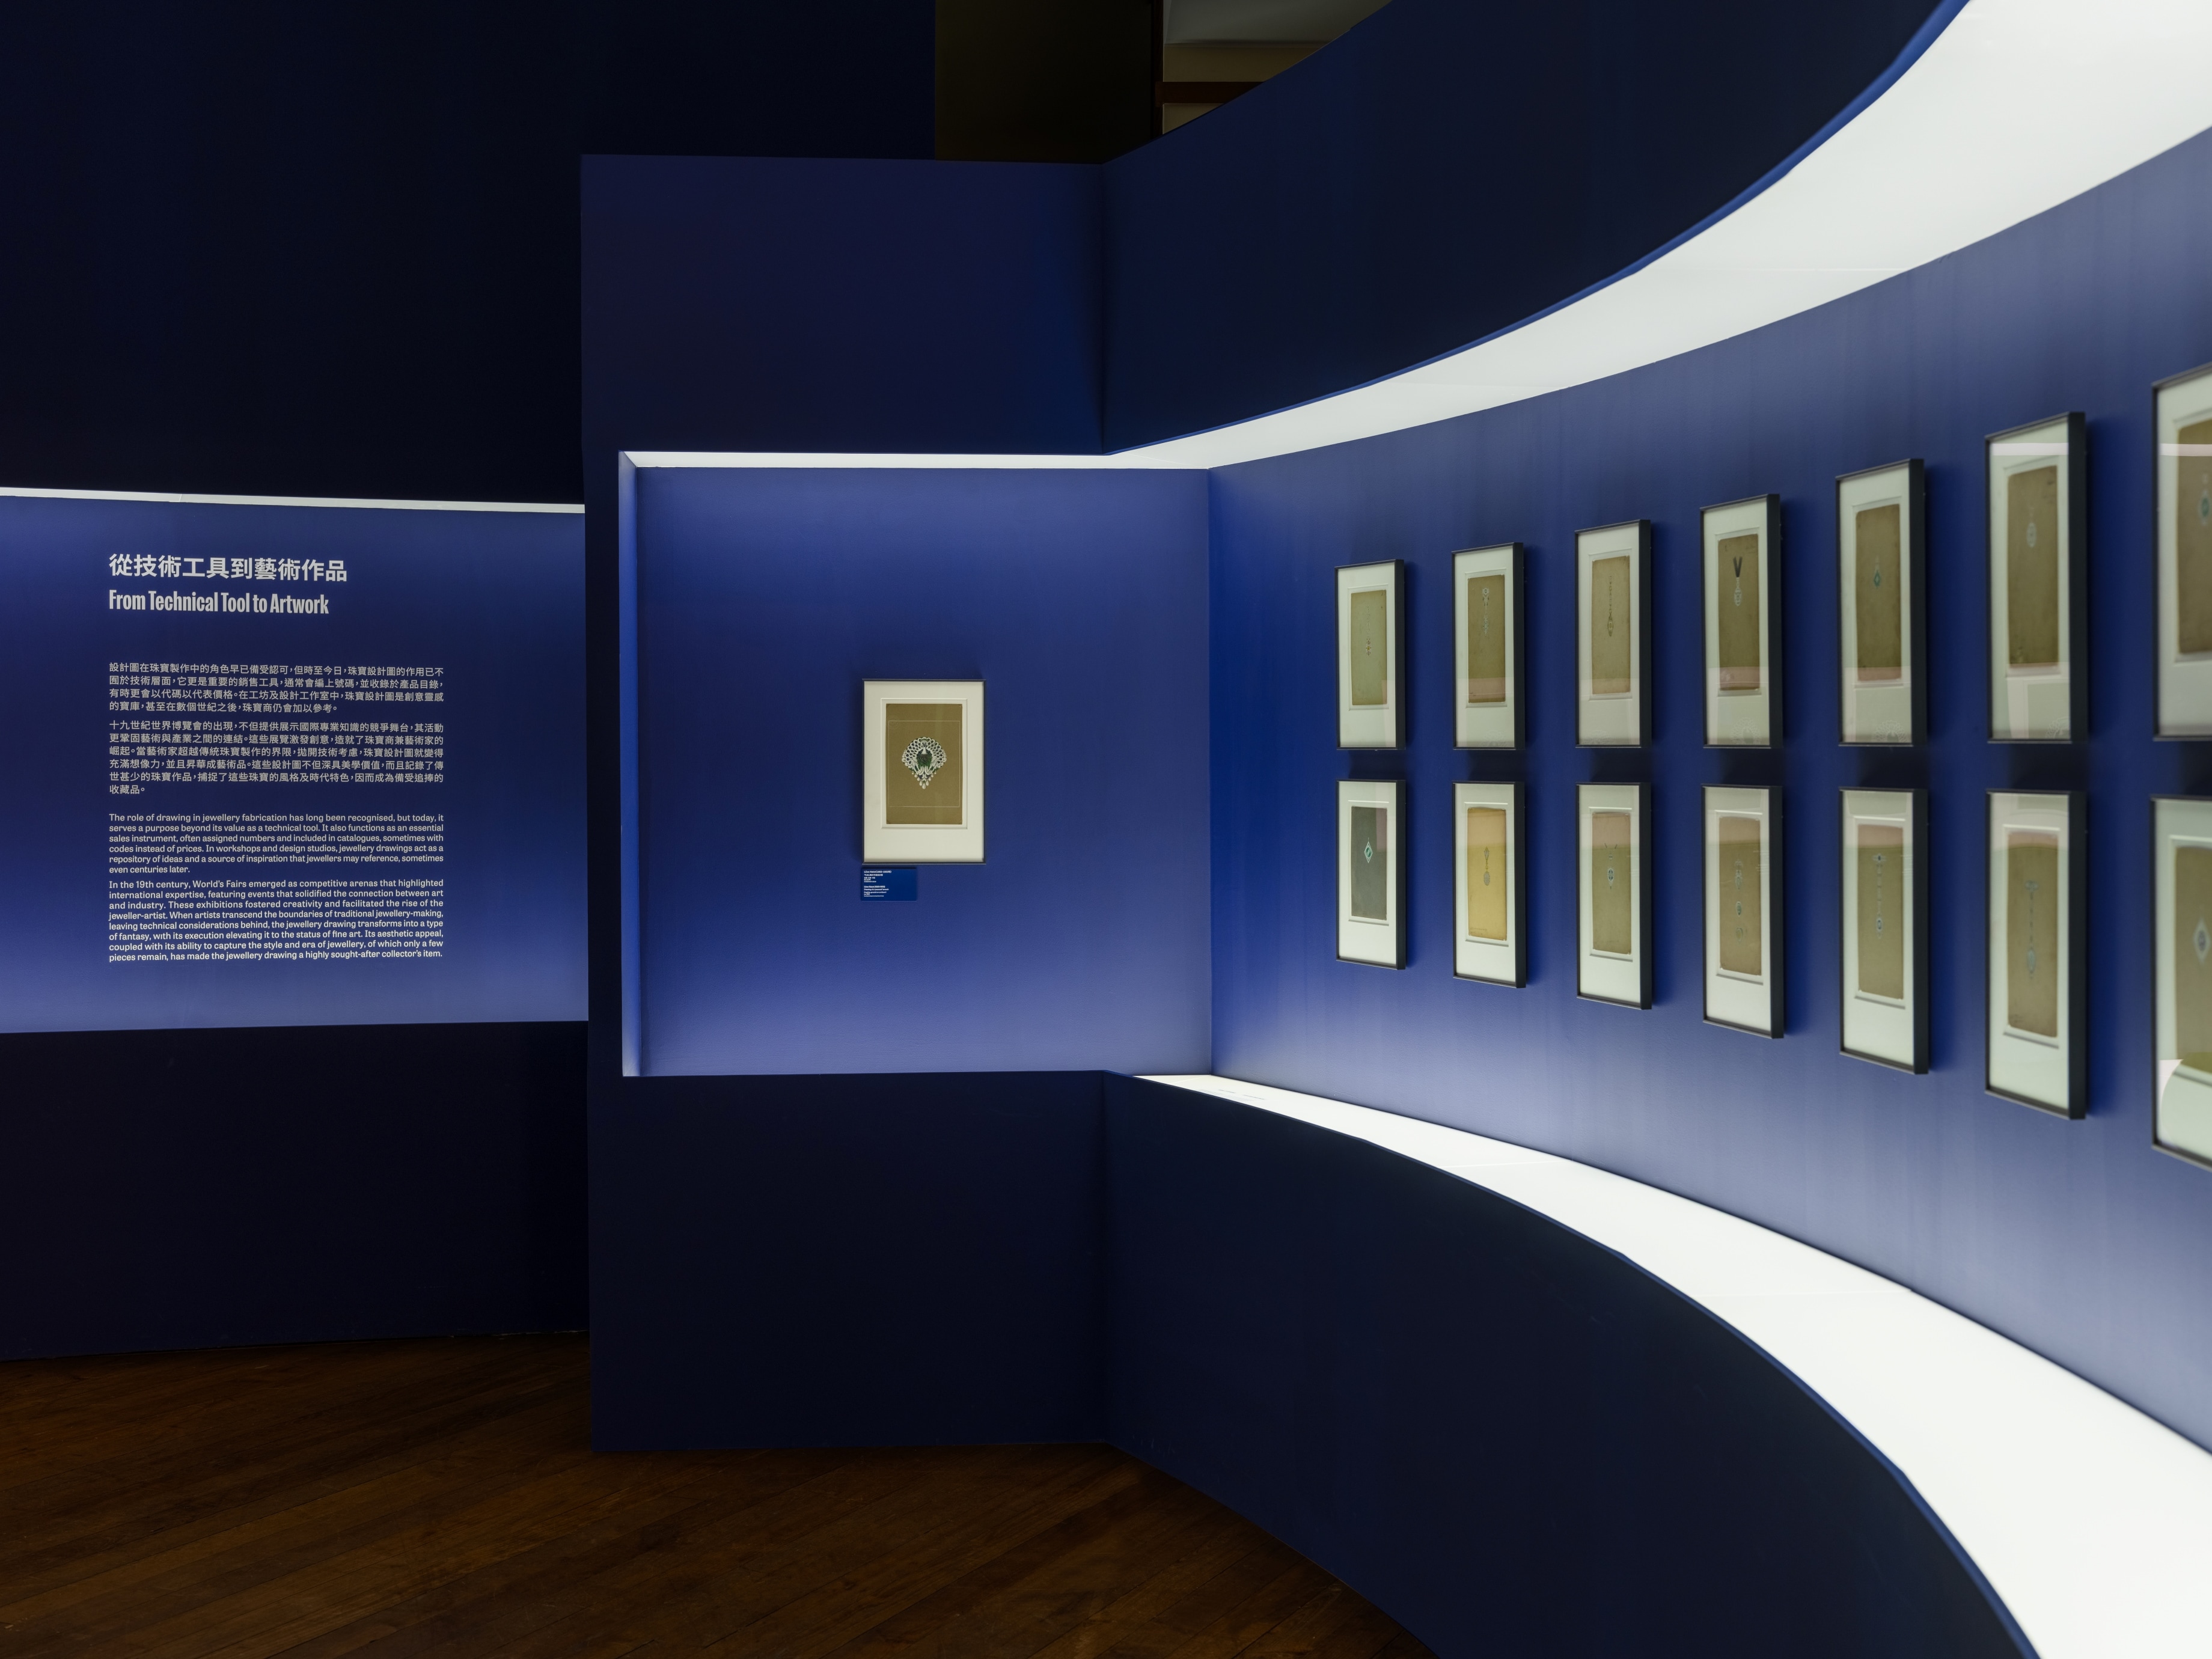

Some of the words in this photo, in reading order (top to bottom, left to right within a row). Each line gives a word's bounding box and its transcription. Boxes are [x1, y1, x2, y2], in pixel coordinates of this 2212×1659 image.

[108, 552, 347, 582] 從技術工具到藝術作品
[109, 589, 146, 610] From
[148, 590, 219, 612] Technical
[220, 592, 250, 613] Tool
[252, 594, 268, 613] to
[269, 593, 329, 614] Artwork
[109, 784, 145, 795] 收藏品。
[156, 814, 190, 822] drawing
[202, 814, 240, 822] jewellery
[306, 814, 323, 822] long
[348, 814, 395, 822] recognised,
[412, 814, 436, 822] today,
[181, 824, 210, 833] beyond
[132, 834, 178, 843] instrument,
[202, 834, 237, 843] assigned
[337, 834, 381, 843] catalogues,
[177, 845, 203, 854] prices.
[216, 845, 260, 854] workshops
[279, 845, 305, 854] design
[307, 845, 337, 853] studios,
[338, 845, 374, 854] jewellery
[376, 845, 412, 854] drawings
[156, 881, 190, 890] century,
[249, 881, 286, 889] emerged
[299, 880, 347, 889] competitive
[399, 879, 443, 888] highlighted
[128, 901, 165, 910] industry.
[283, 900, 322, 909] creativity
[108, 912, 167, 920] jeweller-artist.
[375, 910, 443, 919] jewellery-making,
[119, 932, 151, 941] fantasy,
[226, 932, 262, 940] elevating
[415, 930, 443, 939] appeal,
[109, 943, 142, 952] coupled
[177, 943, 201, 951] ability
[214, 942, 246, 951] capture
[263, 941, 282, 950] style
[327, 941, 365, 950] jewellery,
[404, 941, 420, 949] only
[109, 953, 135, 962] pieces
[225, 952, 262, 961] jewellery
[264, 952, 296, 961] drawing
[305, 952, 329, 960] highly
[331, 951, 380, 960] sought-after
